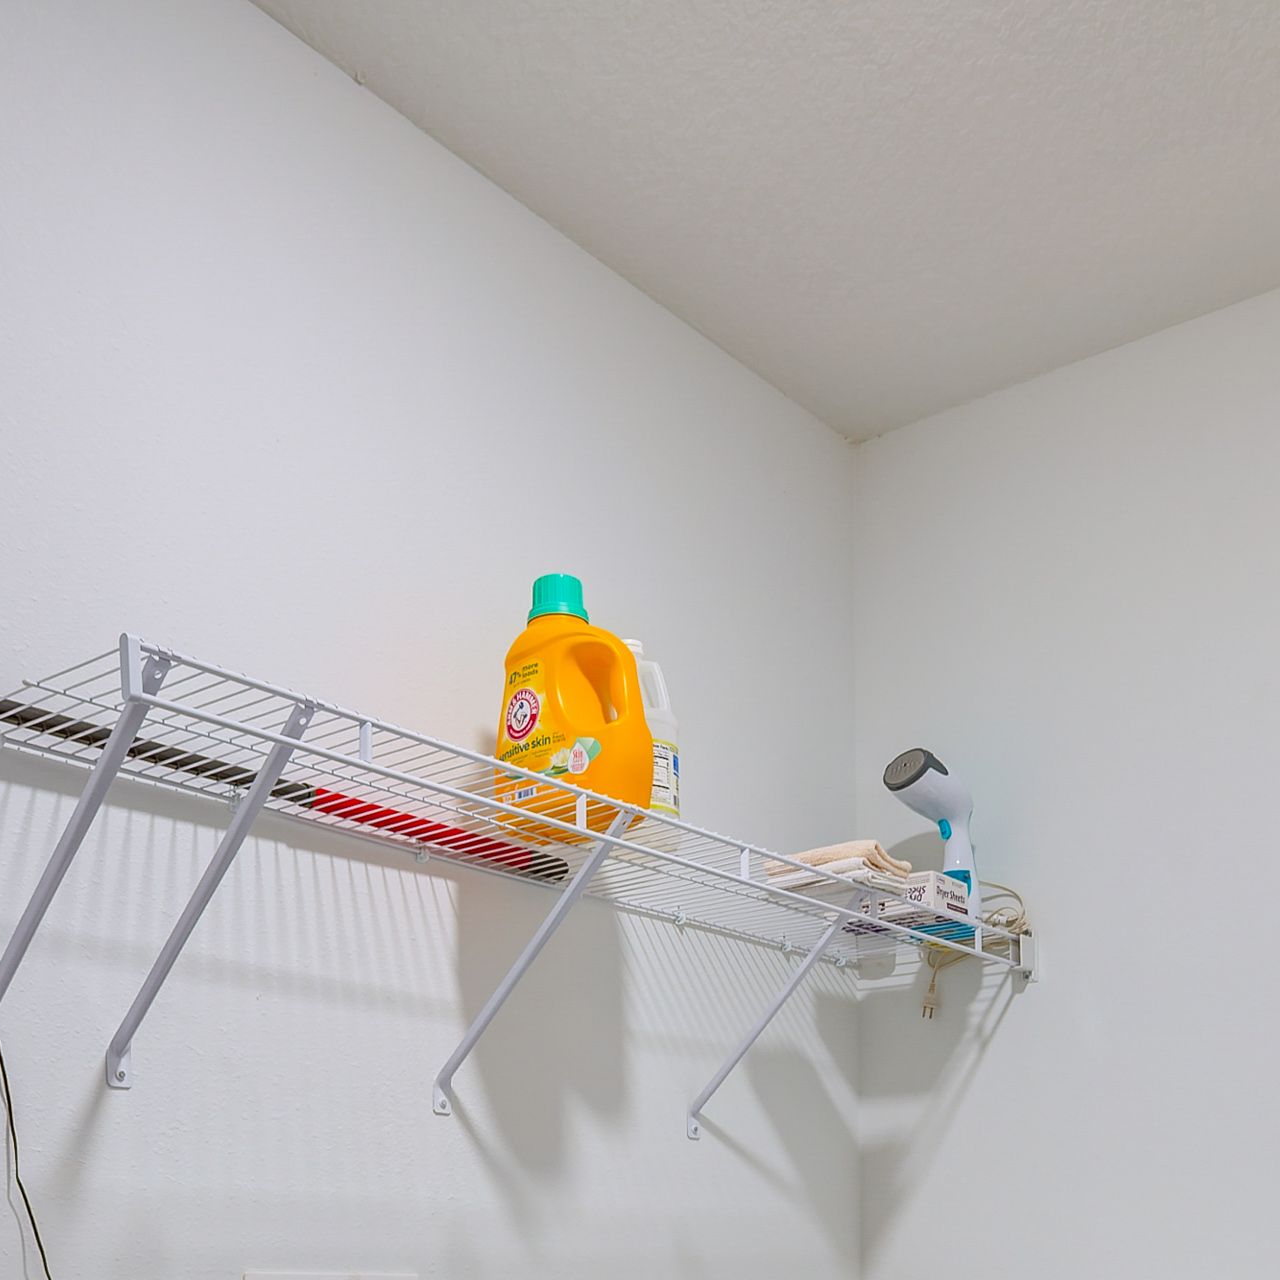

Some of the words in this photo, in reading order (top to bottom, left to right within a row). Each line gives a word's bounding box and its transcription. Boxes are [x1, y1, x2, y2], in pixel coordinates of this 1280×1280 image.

[531, 735, 551, 750] skin
[936, 885, 950, 900] Dryer
[949, 890, 966, 904] Sheets
